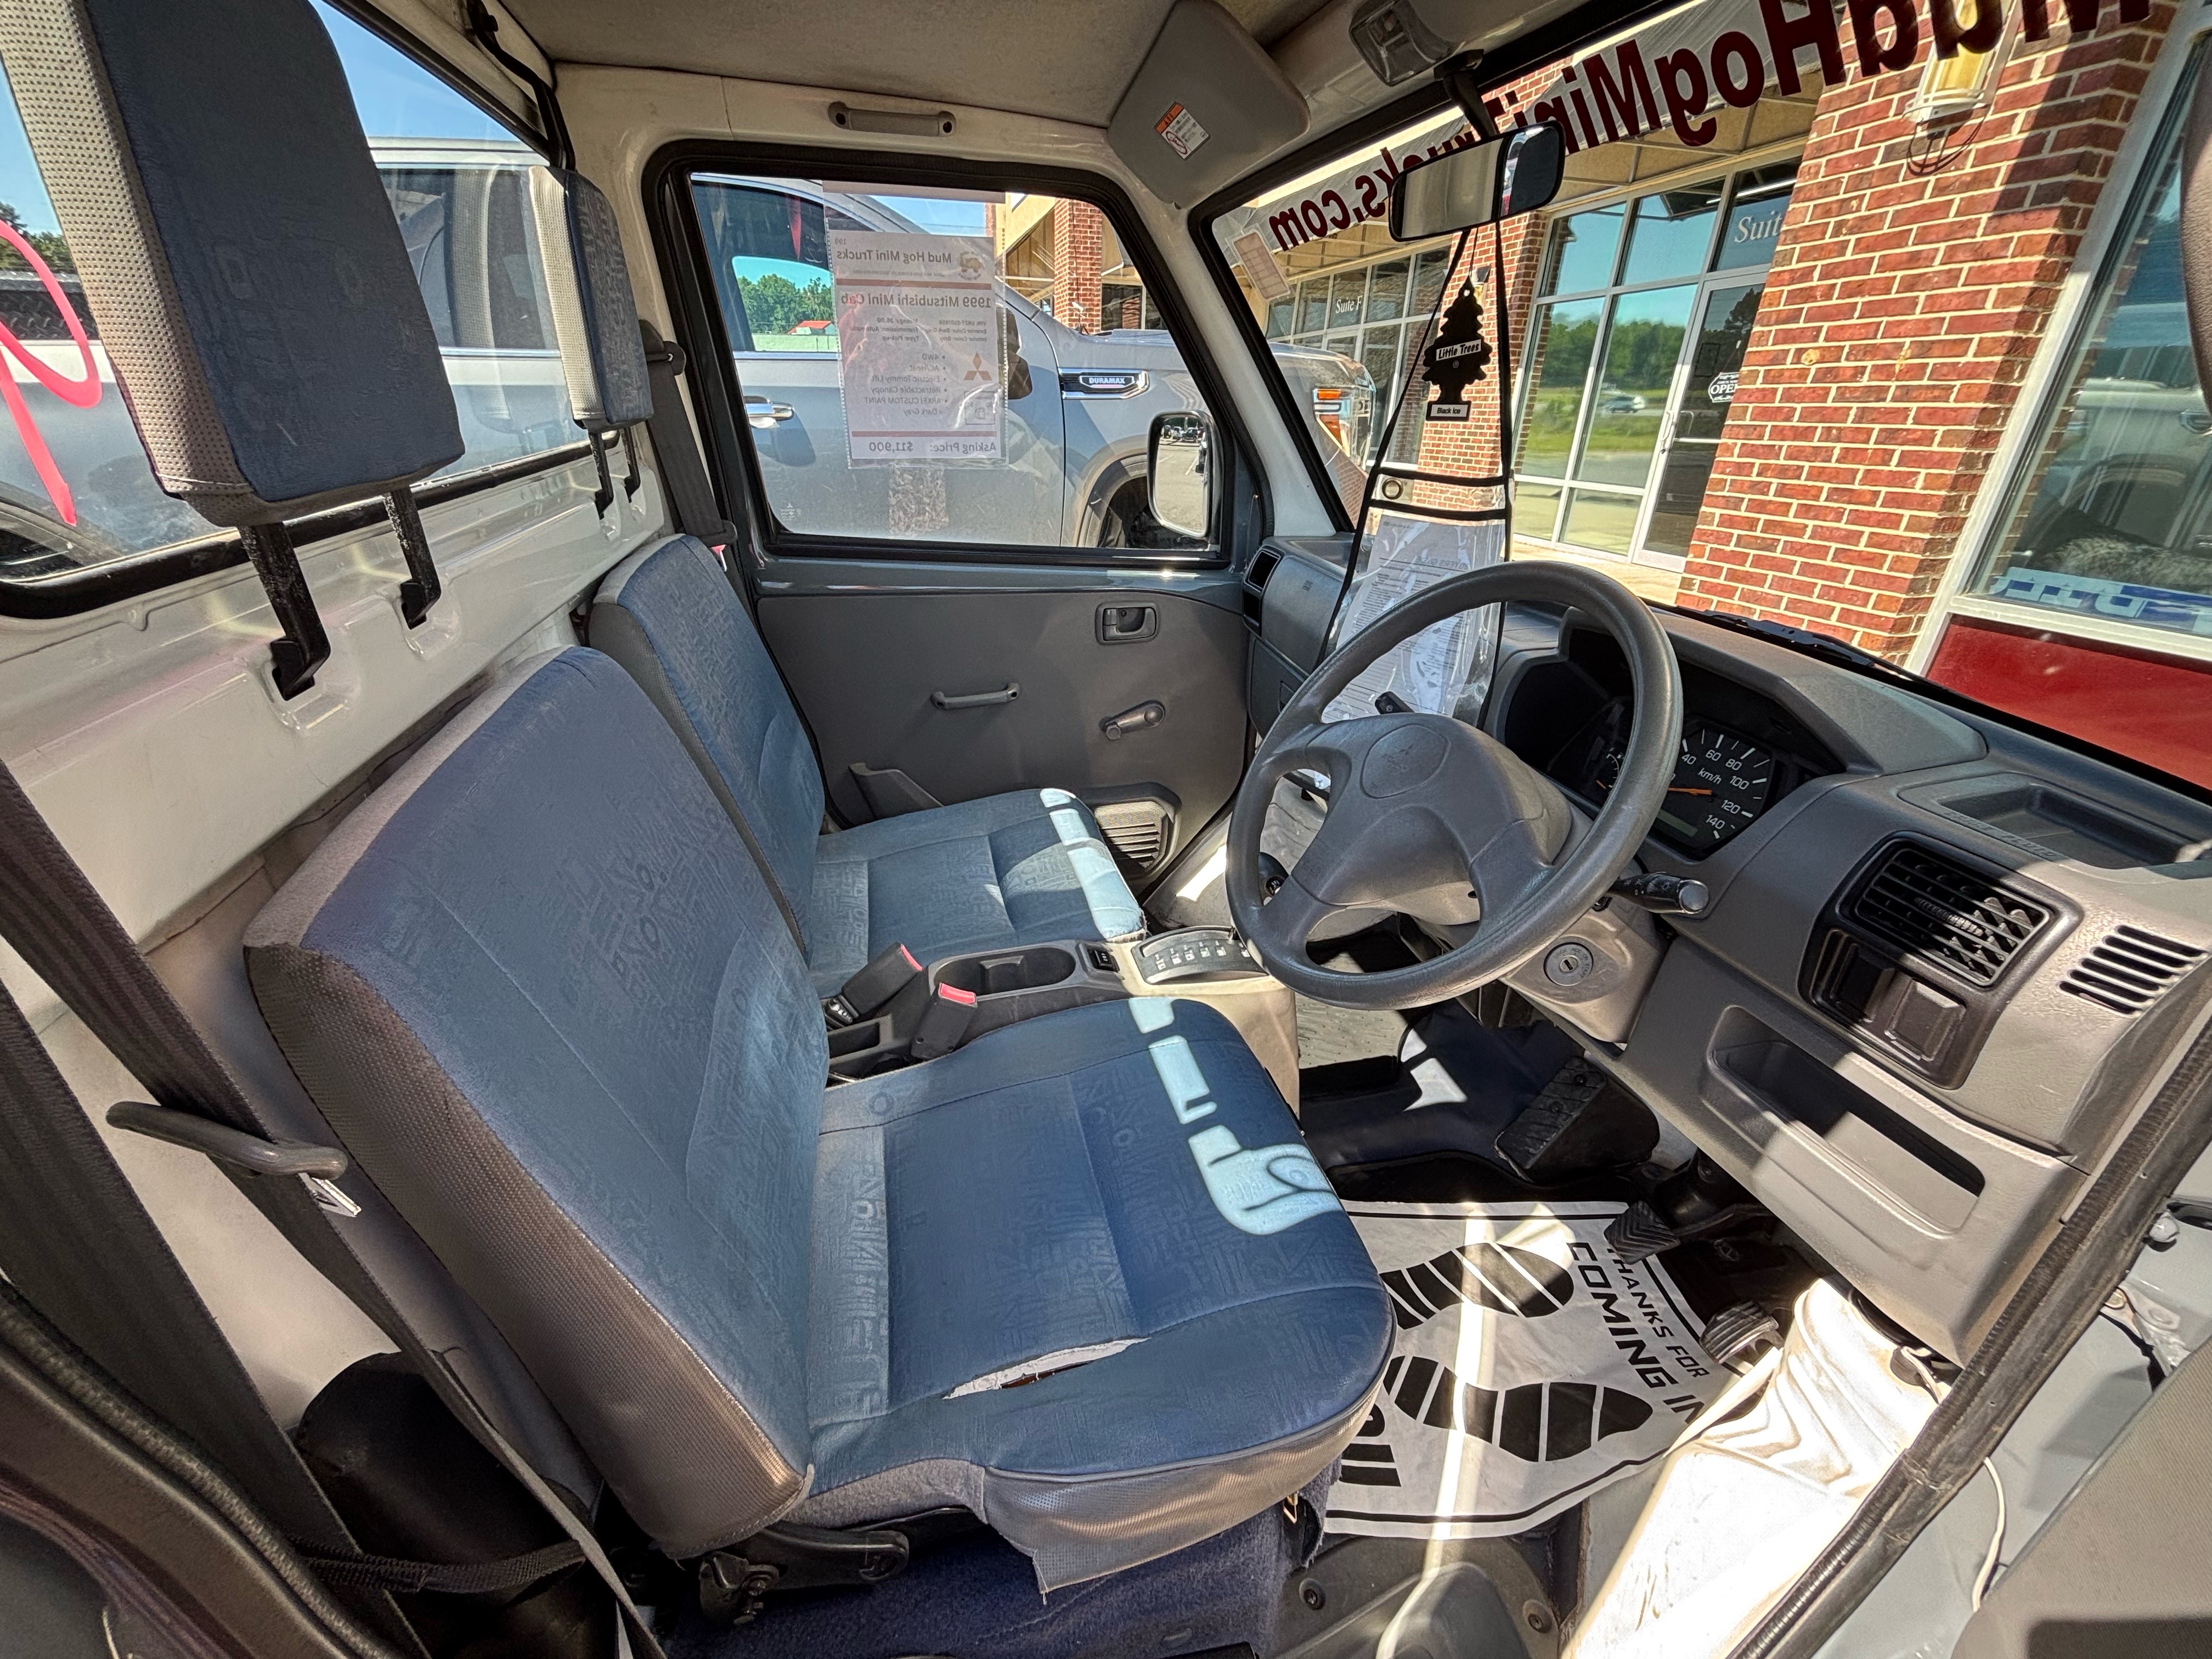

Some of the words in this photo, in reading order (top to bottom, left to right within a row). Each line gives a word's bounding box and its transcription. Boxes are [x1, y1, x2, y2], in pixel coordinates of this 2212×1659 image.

[1734, 210, 1782, 242] Suit
[1335, 297, 1355, 314] Suite
[1356, 295, 1363, 311] F
[1438, 346, 1458, 359] Little
[1460, 343, 1480, 354] Trees
[1711, 384, 1735, 394] OPE
[1681, 754, 1697, 765] 40
[1705, 749, 1722, 761] 60
[1725, 759, 1742, 771] 80
[1698, 768, 1722, 785] km/h
[1729, 775, 1750, 790] 100
[1721, 799, 1741, 814] 120
[1706, 814, 1725, 830] 140
[1566, 1243, 1679, 1389] COMING
[1666, 1346, 1711, 1378] FOR
